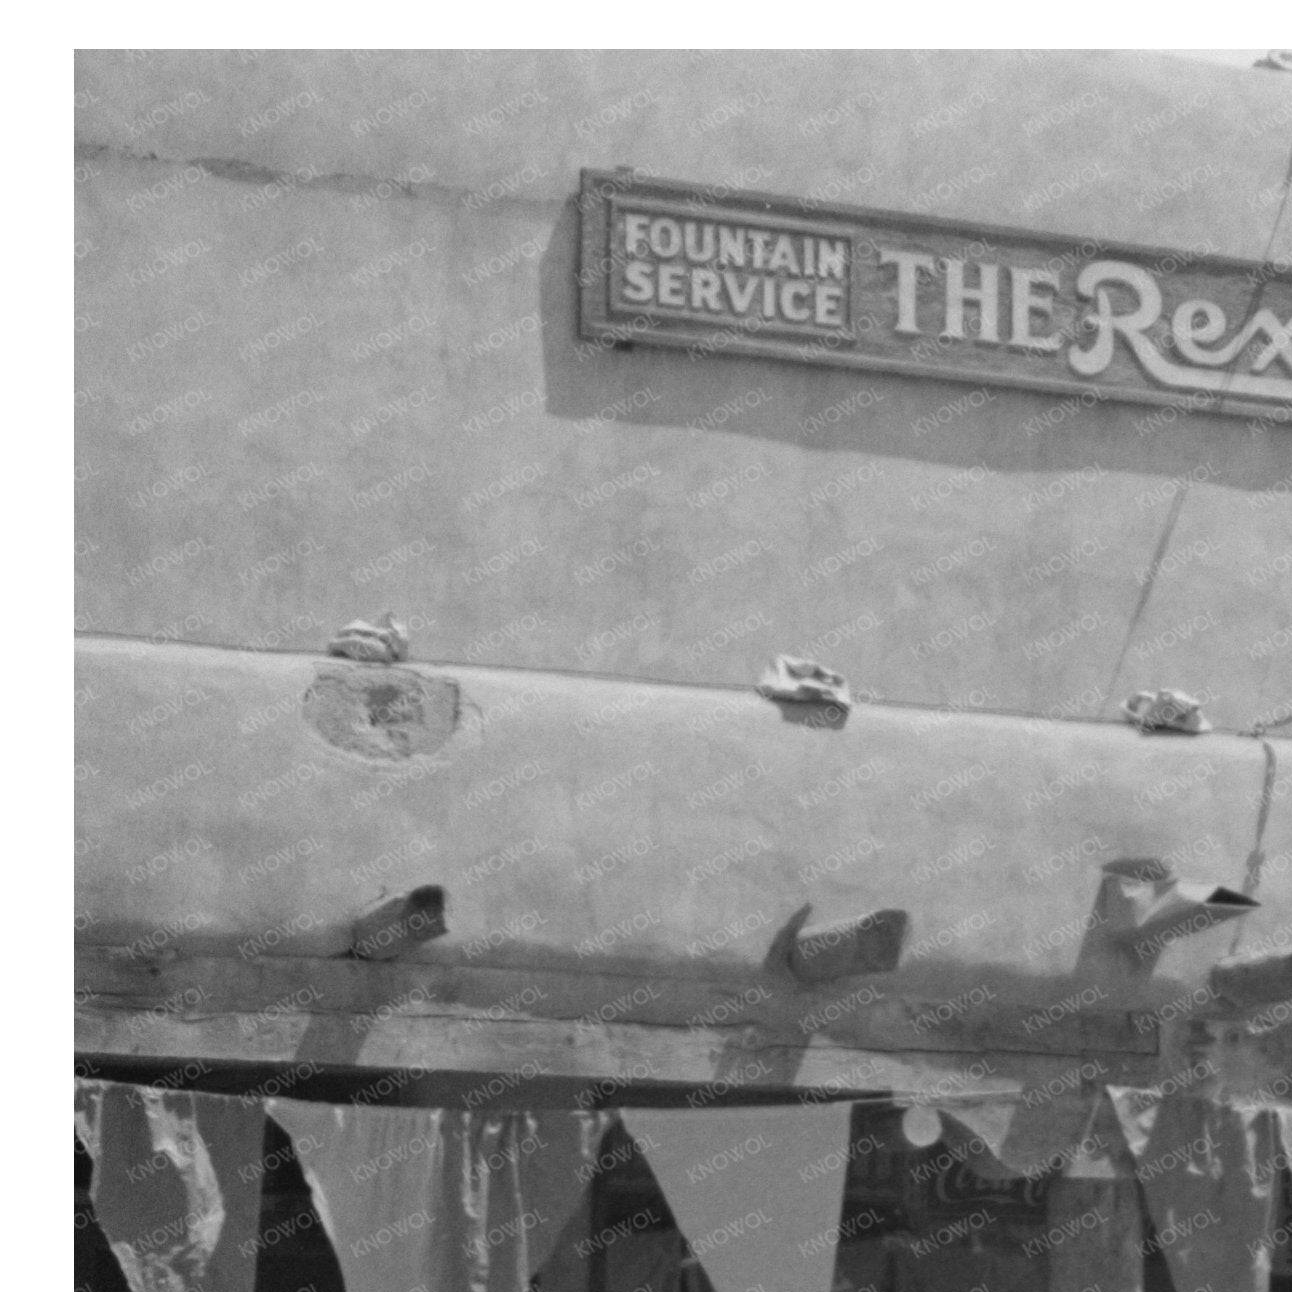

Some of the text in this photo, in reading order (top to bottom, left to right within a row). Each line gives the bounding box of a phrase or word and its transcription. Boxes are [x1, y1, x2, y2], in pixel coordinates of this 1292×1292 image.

[623, 212, 847, 279] FOUNTAIN
[622, 260, 844, 327] SERVICE
[879, 248, 1062, 352] THE
